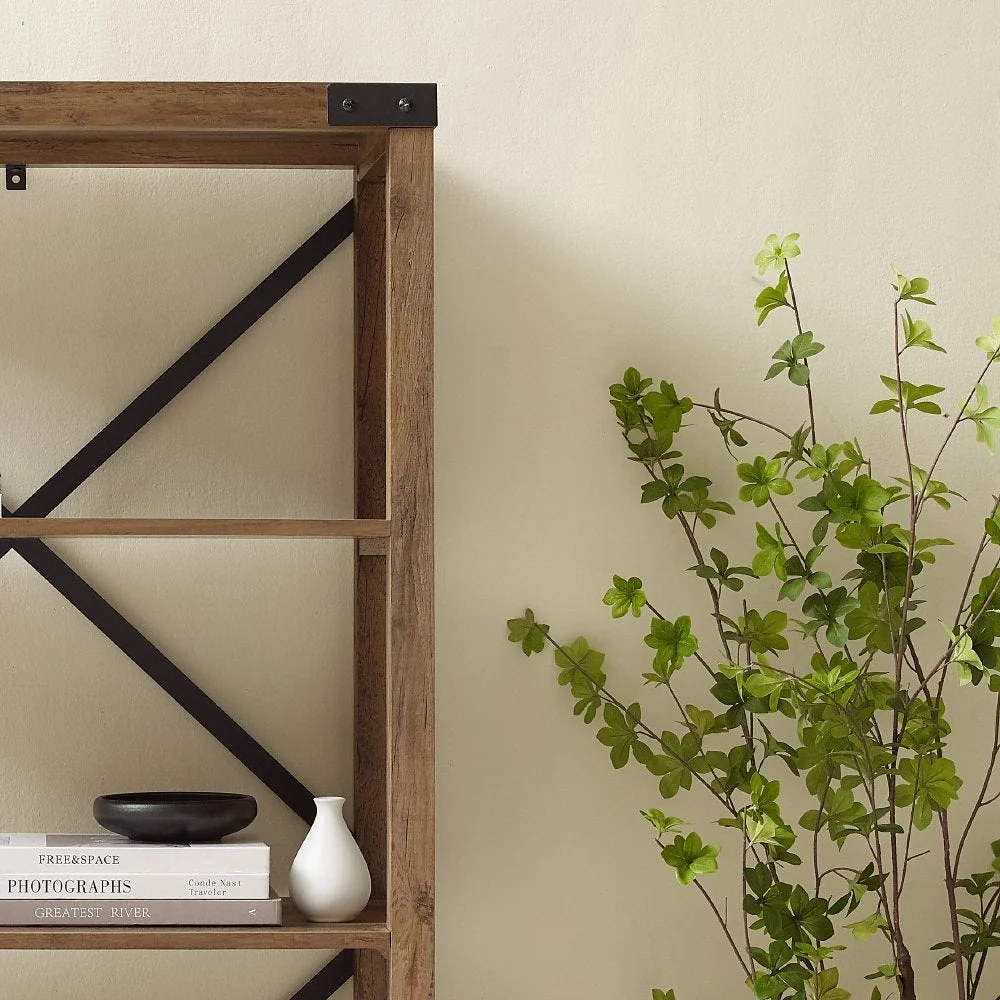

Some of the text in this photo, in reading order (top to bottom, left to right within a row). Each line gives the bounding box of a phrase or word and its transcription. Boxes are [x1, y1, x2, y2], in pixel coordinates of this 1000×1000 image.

[38, 854, 120, 865] FREE&SPACE
[7, 879, 132, 894] PHOTOGRAPHS
[188, 879, 241, 887] Conde Nast
[188, 888, 227, 896] Traveler
[34, 907, 151, 919] GREATEST RIVER
